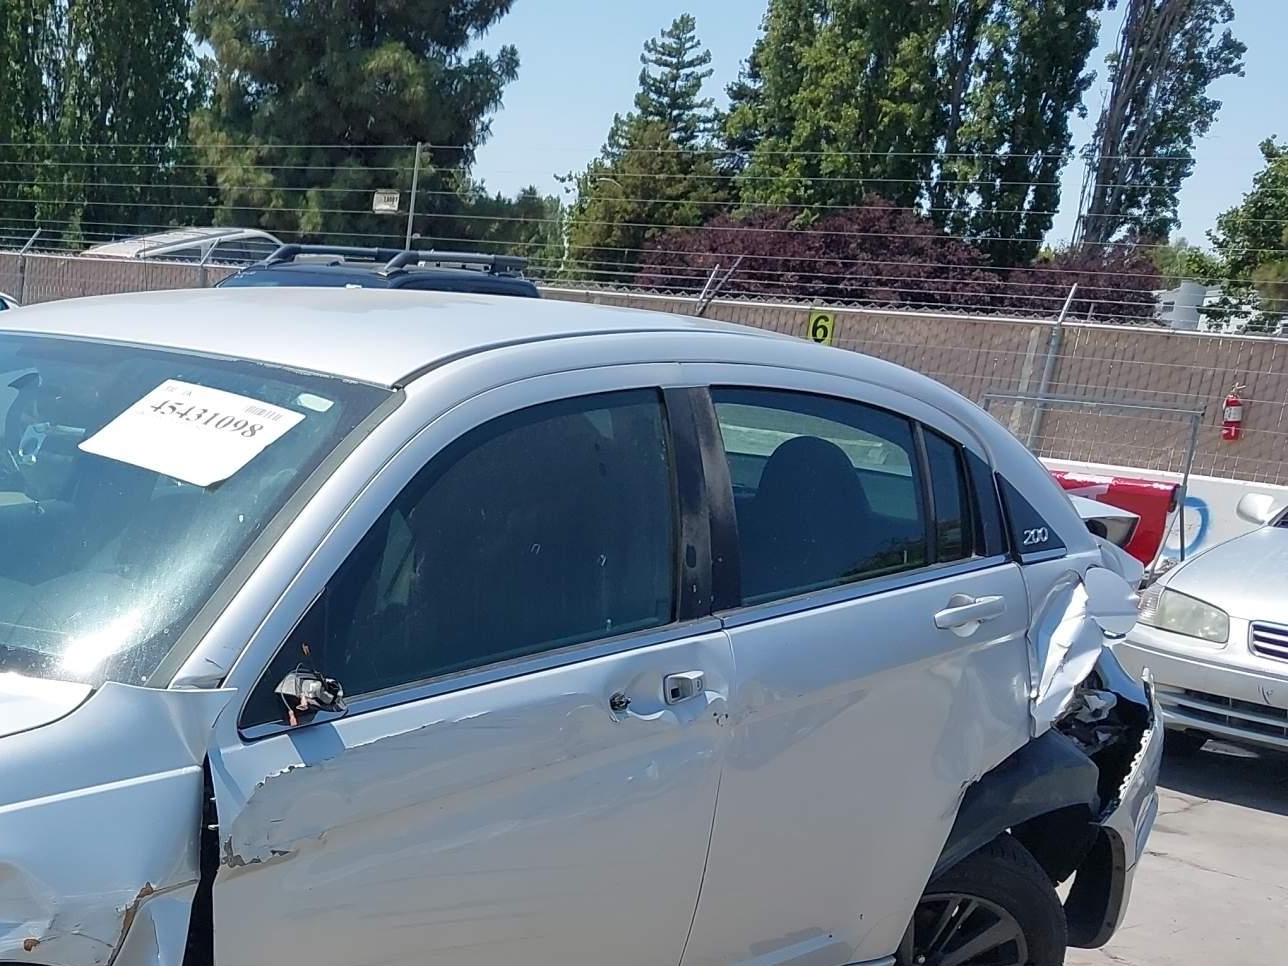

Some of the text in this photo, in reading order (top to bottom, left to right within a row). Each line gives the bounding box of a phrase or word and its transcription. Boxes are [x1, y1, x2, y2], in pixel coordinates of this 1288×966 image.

[812, 315, 829, 343] 6
[150, 399, 264, 438] 45431098
[1023, 526, 1049, 546] 200
